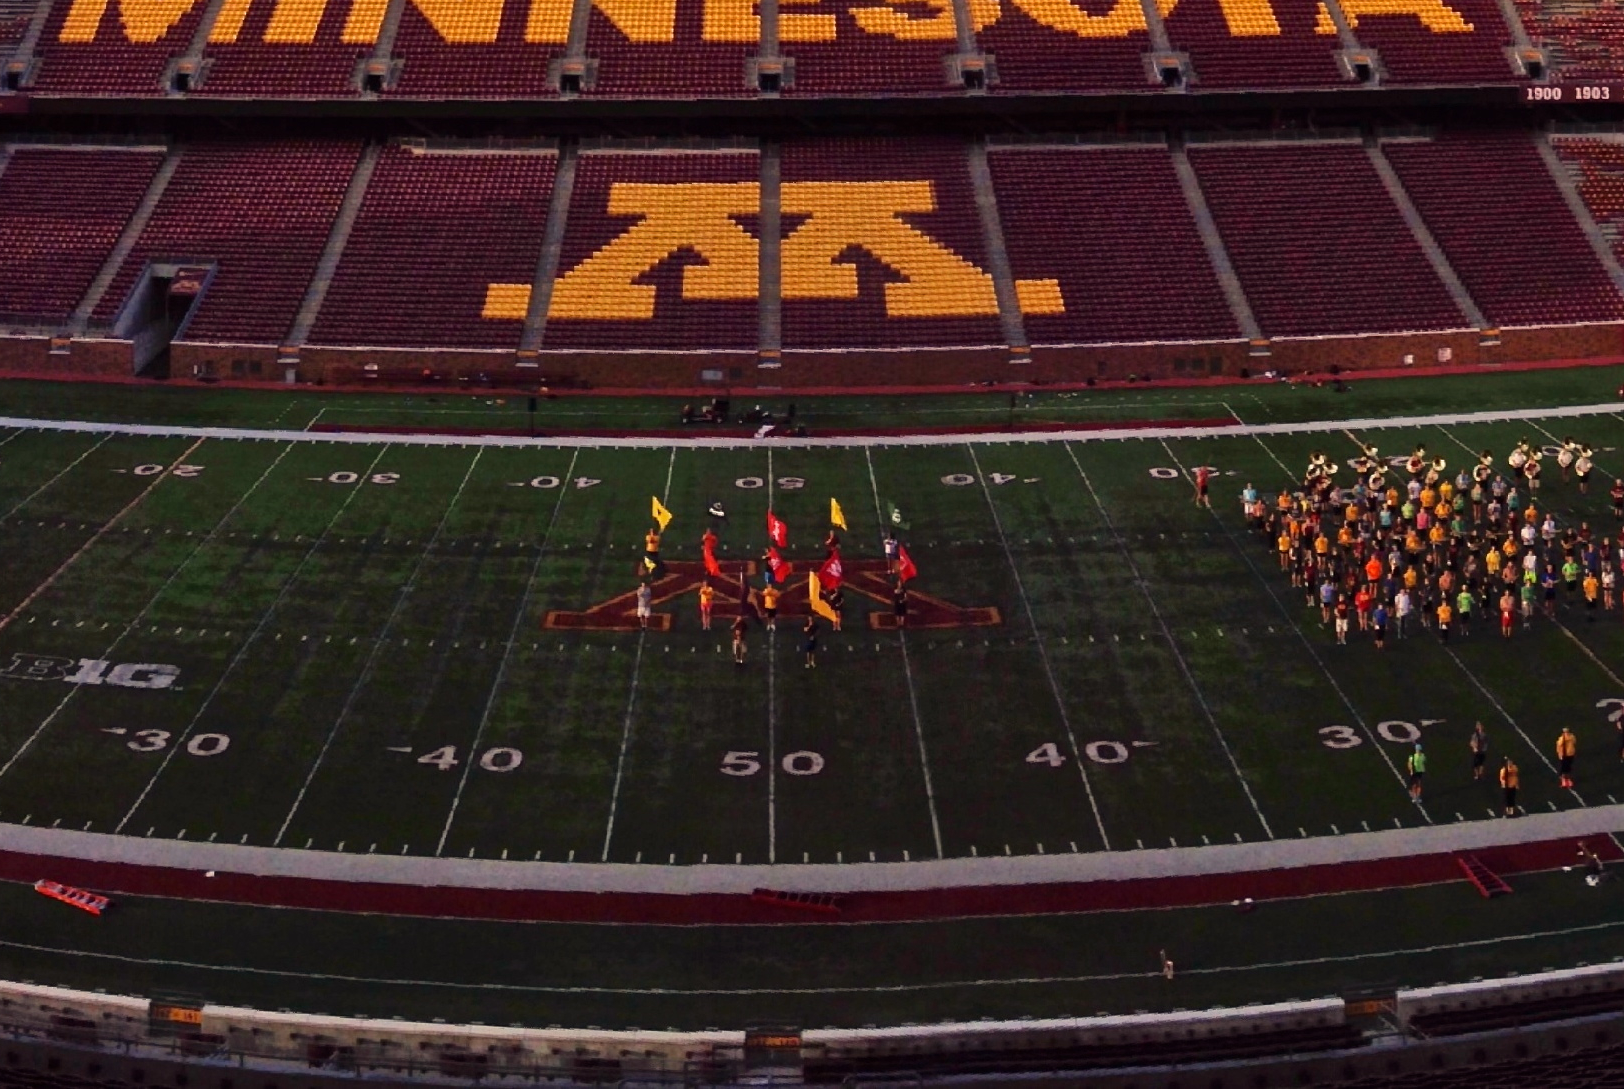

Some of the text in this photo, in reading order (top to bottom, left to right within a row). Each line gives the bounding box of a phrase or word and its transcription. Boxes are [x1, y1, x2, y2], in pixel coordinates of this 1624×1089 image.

[1526, 86, 1561, 100] 1900
[1575, 86, 1610, 100] 1903
[133, 463, 205, 477] 20
[329, 471, 401, 484] 30
[531, 475, 602, 489] 40
[736, 476, 806, 490] 50
[941, 472, 1017, 486] 40
[1319, 720, 1421, 750] 30
[127, 728, 230, 757] 30
[417, 744, 523, 772] 40
[1025, 740, 1131, 768] 40
[721, 751, 825, 776] 50
